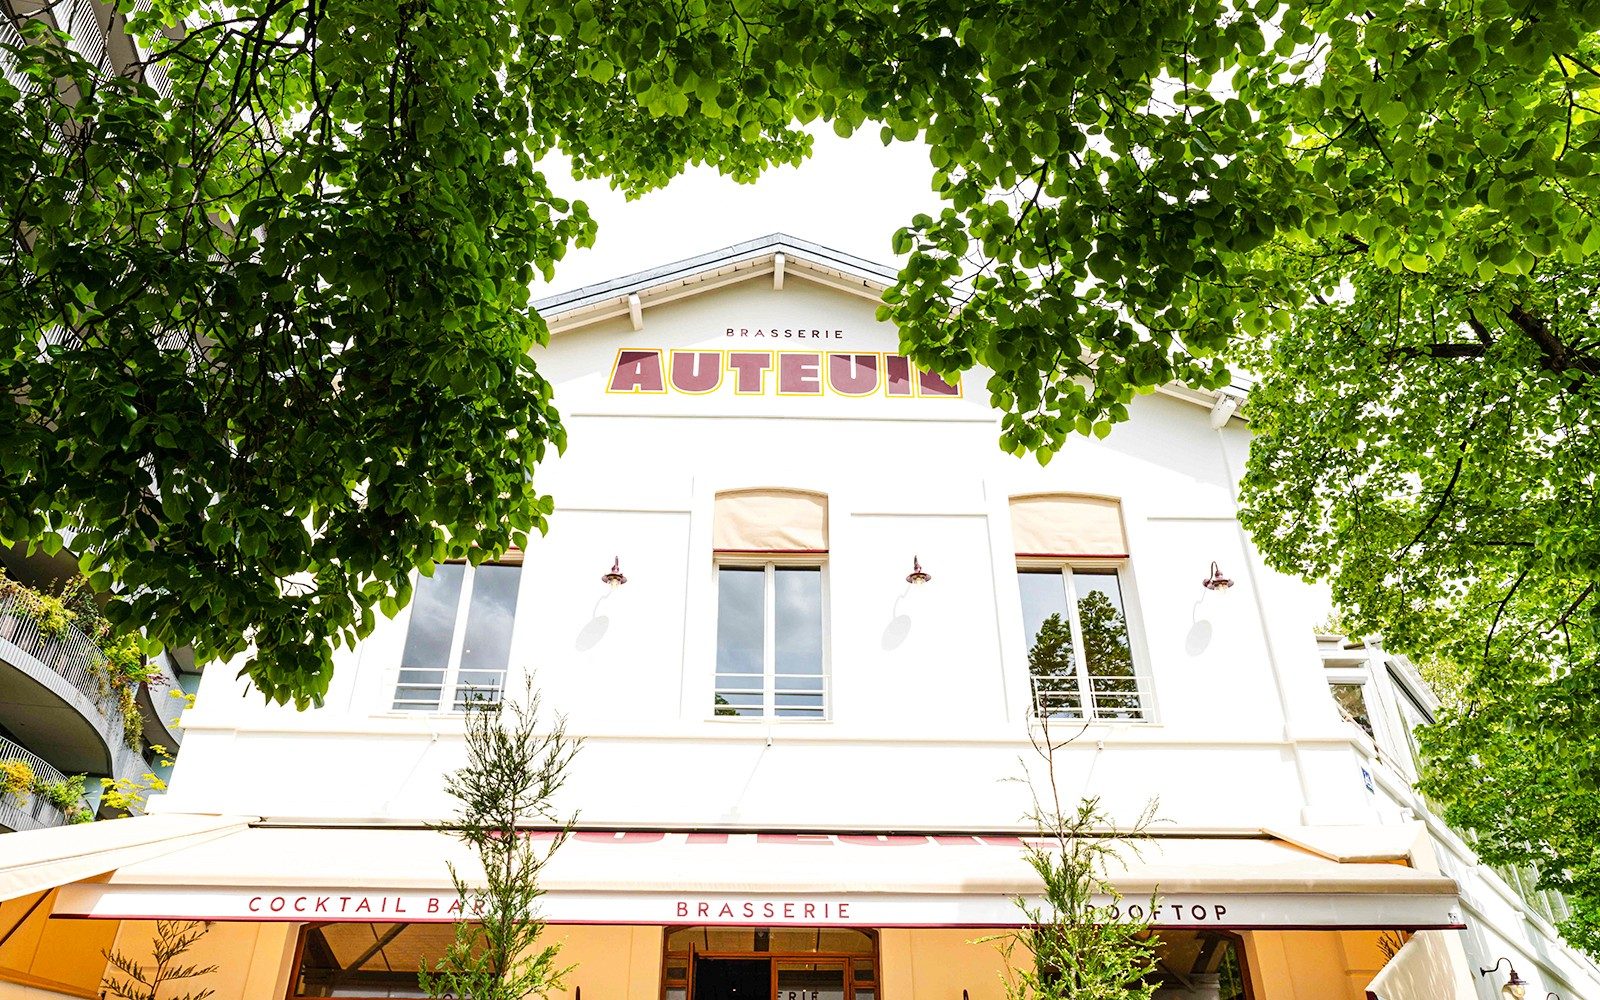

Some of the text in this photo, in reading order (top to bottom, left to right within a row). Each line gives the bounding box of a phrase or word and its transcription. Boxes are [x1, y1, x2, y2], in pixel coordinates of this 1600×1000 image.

[725, 327, 844, 339] BRASSERIE
[248, 895, 486, 914] COCKTAIL BAR
[676, 901, 850, 919] BRASSERIE
